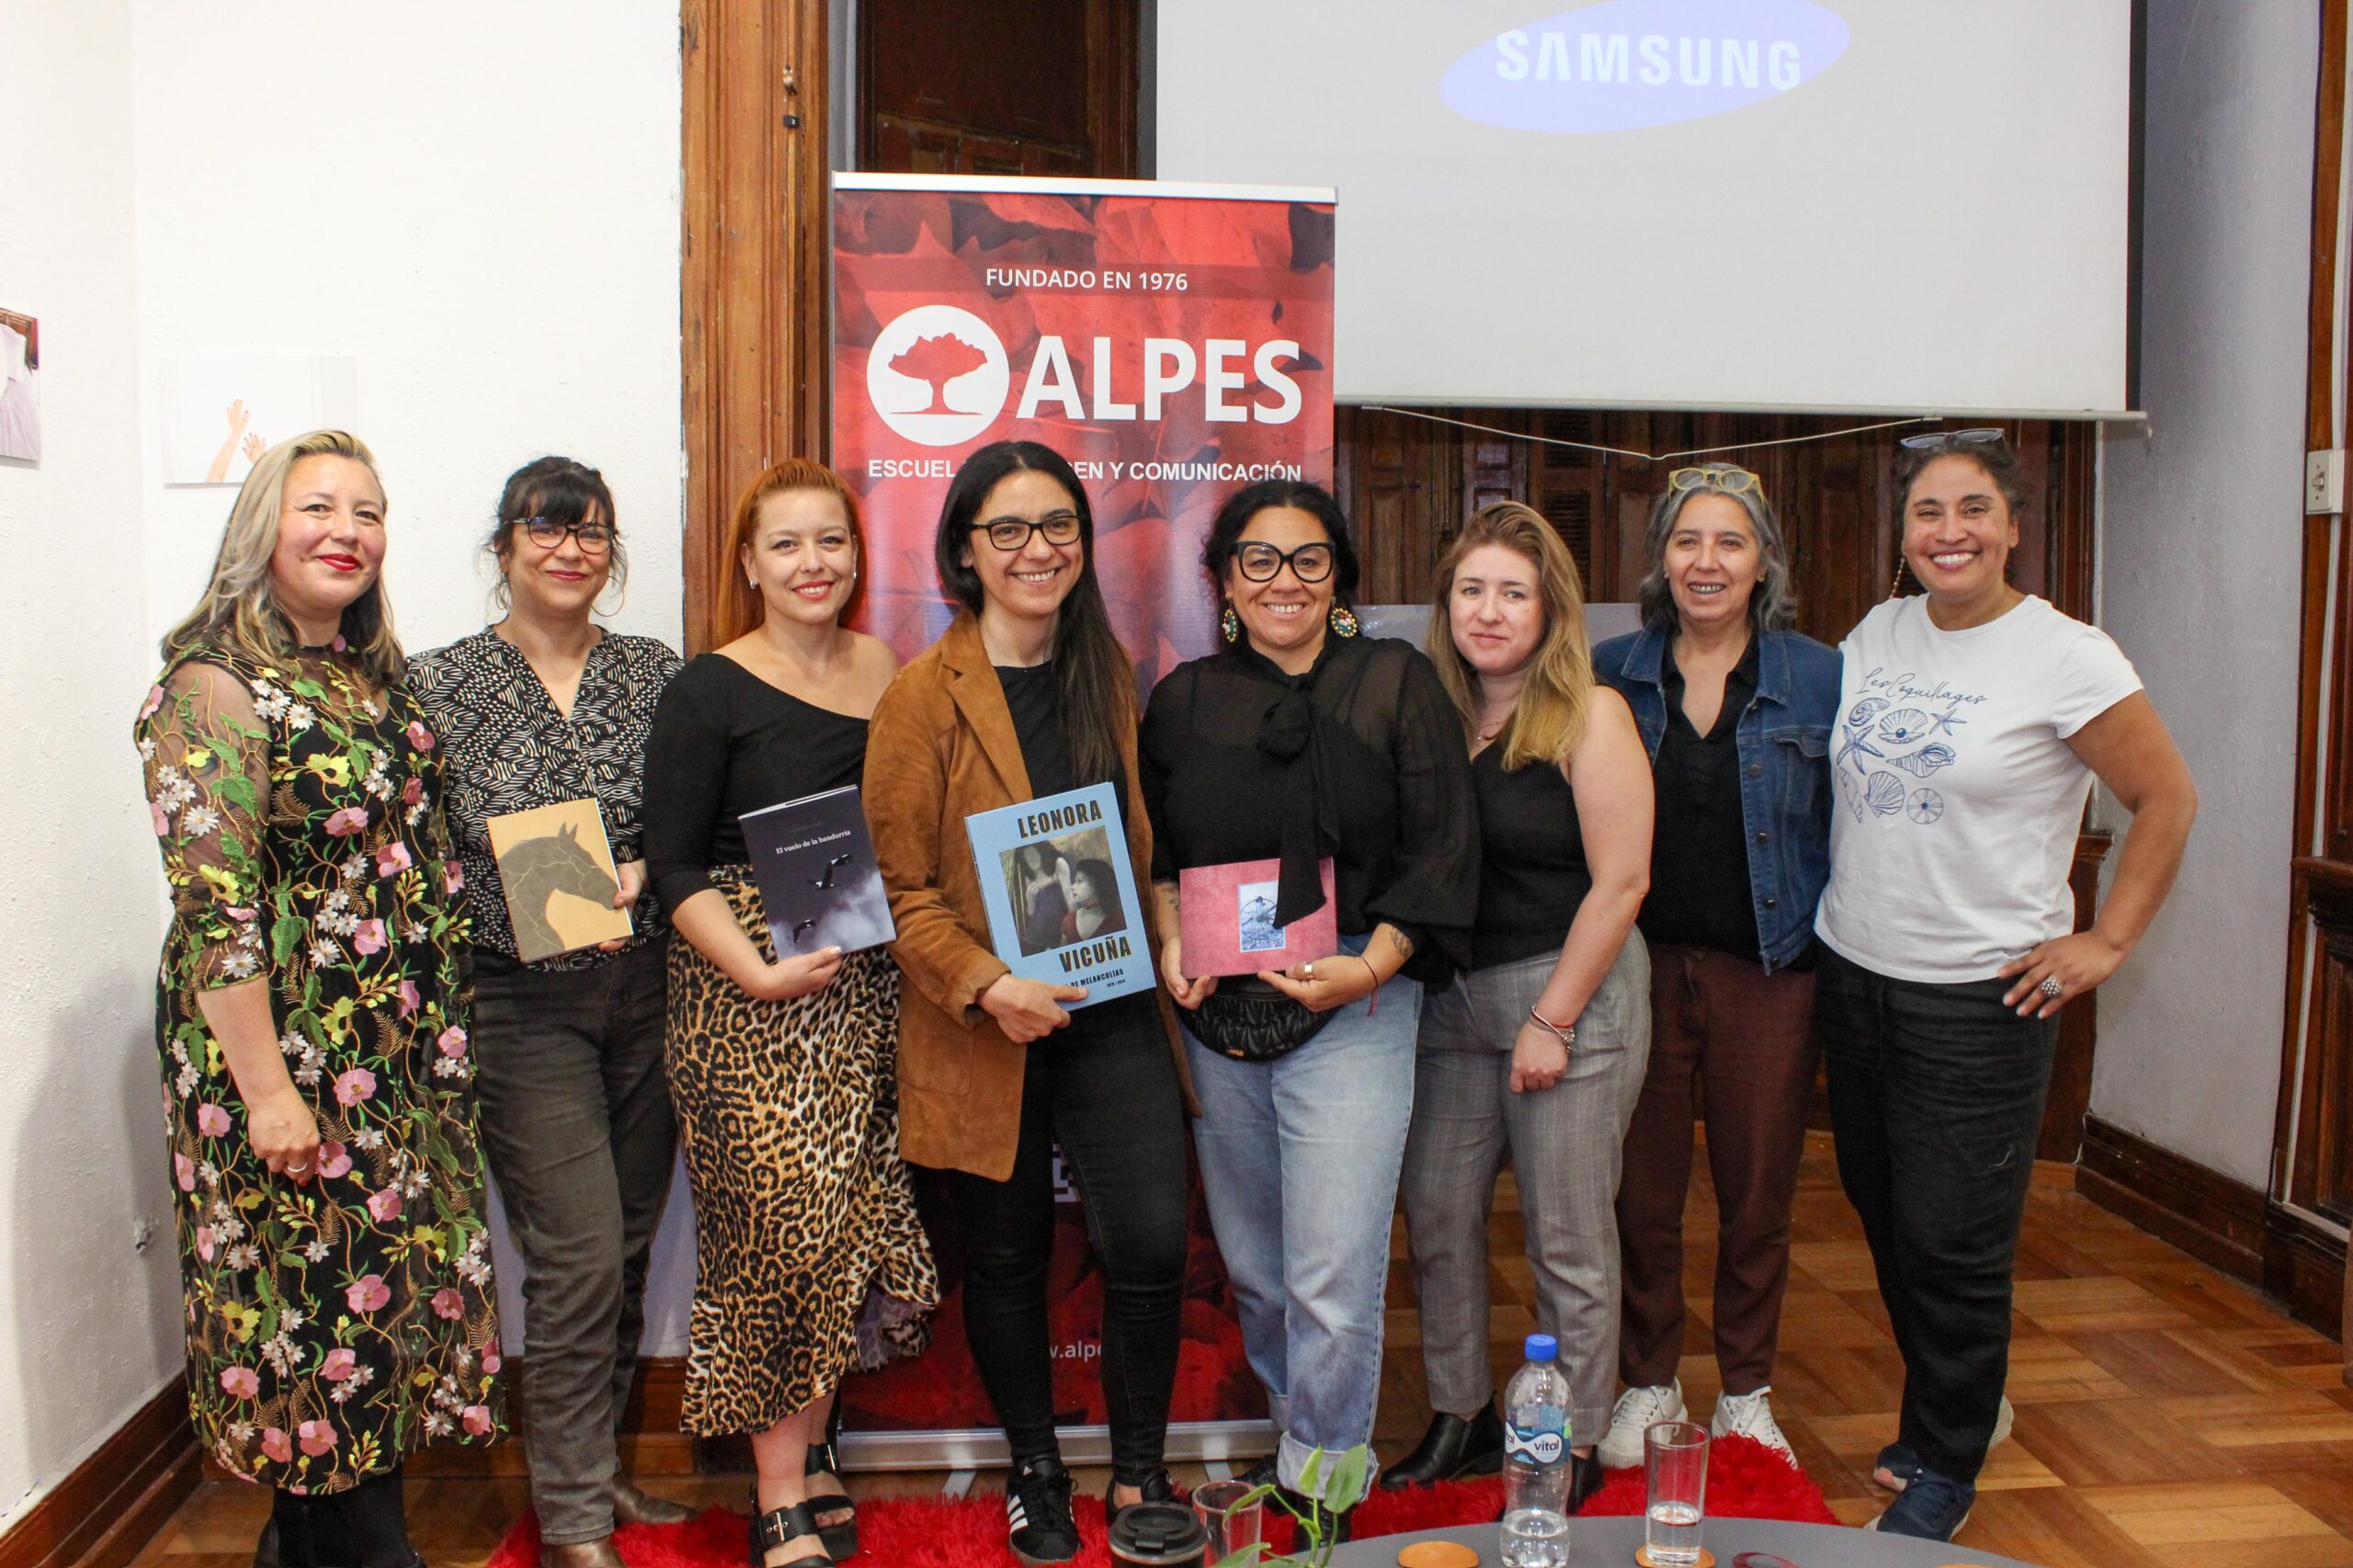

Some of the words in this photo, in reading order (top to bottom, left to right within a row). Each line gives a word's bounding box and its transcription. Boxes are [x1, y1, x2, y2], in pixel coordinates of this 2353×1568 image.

[1495, 28, 1802, 90] SAMSUNG
[986, 268, 1096, 289] FUNDADO
[1103, 271, 1131, 290] EN
[1139, 272, 1188, 291] 1976
[1016, 335, 1302, 425] ALPES
[868, 459, 962, 479] ESCUEL
[1109, 461, 1125, 480] Y
[1129, 460, 1302, 483] COMUNICACIÓN
[1855, 666, 1893, 695] Les
[1885, 672, 1987, 710] Coquillages
[1017, 800, 1103, 839] LEONORA
[783, 843, 801, 853] vuelo
[811, 837, 818, 846] la
[818, 830, 851, 843] bandurria
[1058, 935, 1132, 973] VICUÑA
[1080, 968, 1124, 986] MELANCOLÍAS
[1534, 1438, 1560, 1451] vital
